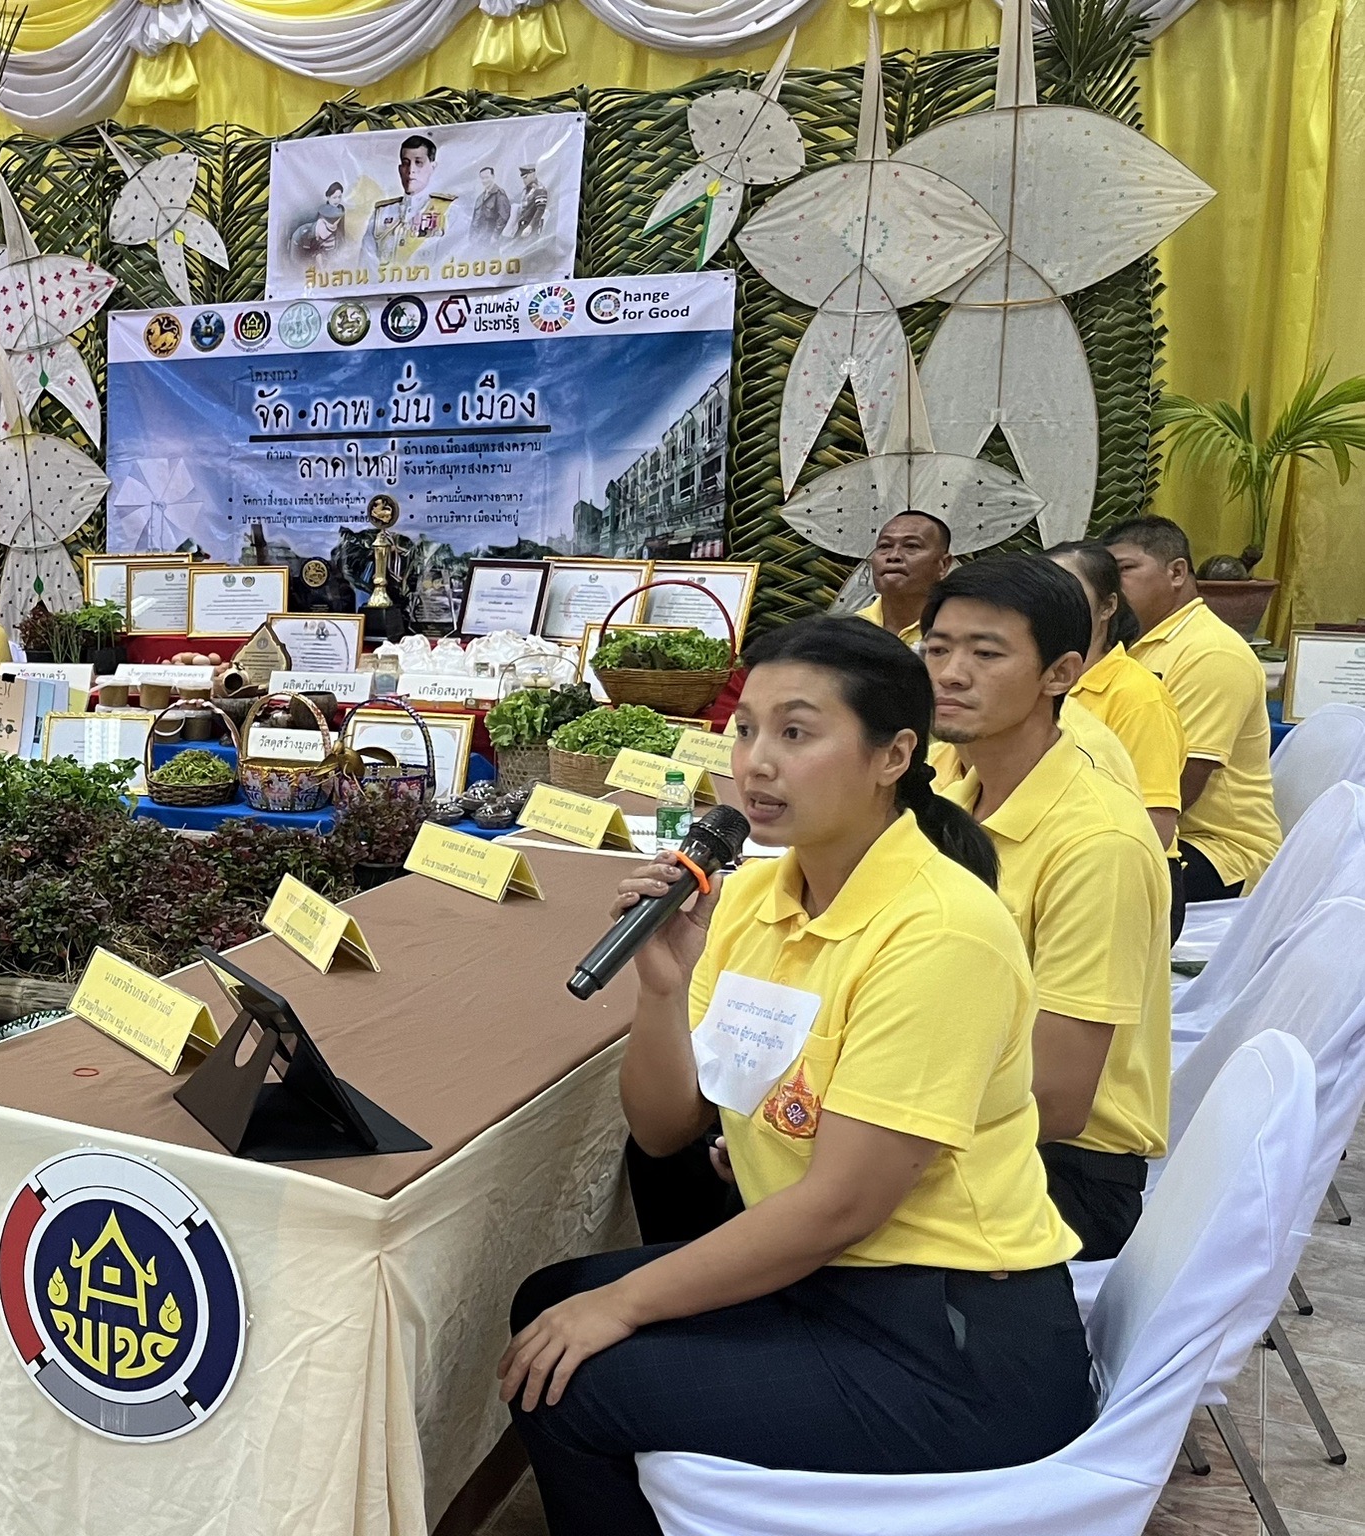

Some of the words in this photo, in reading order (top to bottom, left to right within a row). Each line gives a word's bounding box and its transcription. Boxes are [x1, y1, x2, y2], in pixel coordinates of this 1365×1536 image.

[305, 263, 369, 288] สืบสาน
[377, 261, 430, 284] รักษา
[441, 257, 521, 279] ต่อยอด
[475, 297, 519, 314] สานพลัง
[623, 307, 643, 321] for
[649, 306, 690, 320] Good
[473, 314, 519, 334] ประชารัฐ
[249, 366, 298, 383] โครงการ
[255, 388, 290, 429] จัด
[310, 399, 369, 427] ภาพ
[391, 364, 430, 424] มั่น
[459, 374, 537, 421] เมือง
[403, 438, 541, 460] อำเภอเมืองสมุทรสงคราม
[266, 446, 292, 460] ตำบล
[298, 440, 397, 486] ลาดใหญ่
[403, 461, 511, 480] จังหวัดสมุทรสงคราม
[282, 678, 356, 699] ผลิตภัณฑ์แปรรูป
[419, 683, 473, 698] เกลือสมุทร
[259, 735, 324, 754] วัสดุสร้างมูลค่า
